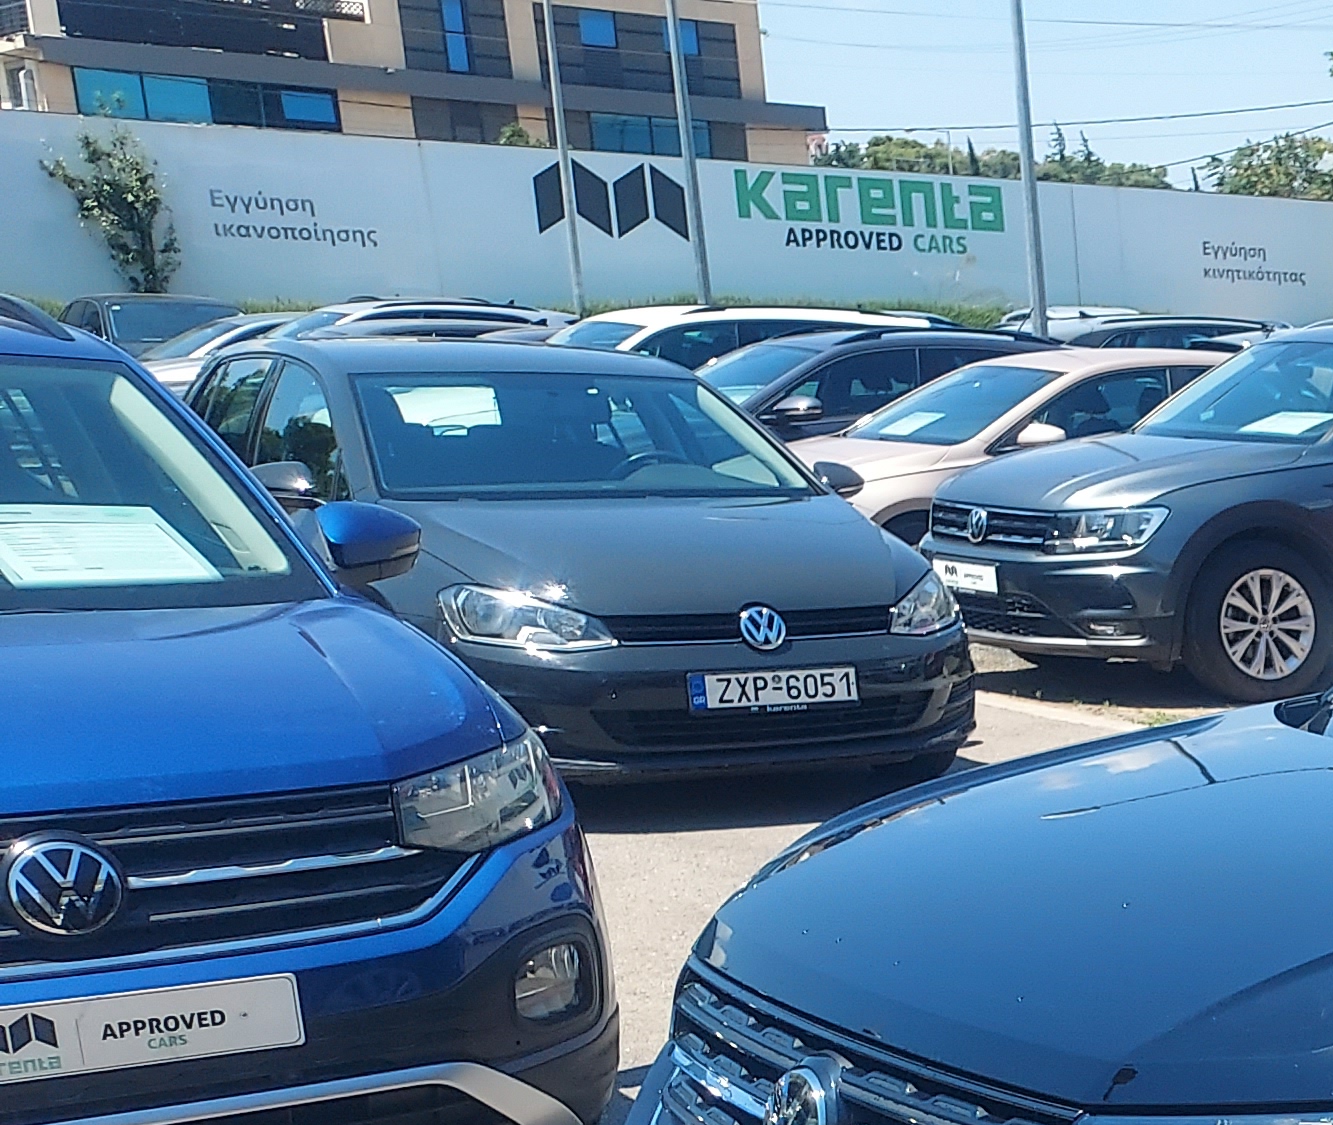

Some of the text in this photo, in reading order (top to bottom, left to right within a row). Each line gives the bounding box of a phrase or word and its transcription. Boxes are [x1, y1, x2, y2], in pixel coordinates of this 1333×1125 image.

[208, 187, 316, 218] Εγγύηση
[213, 221, 379, 248] ικανοποίησης
[785, 227, 969, 255] APPROVED CARS
[1202, 240, 1267, 262] Εγγύηση
[1203, 265, 1306, 286] κινητικότητας
[101, 1009, 227, 1041] APPROVED
[147, 1035, 188, 1050] CARS
[0, 1056, 62, 1076] renta
